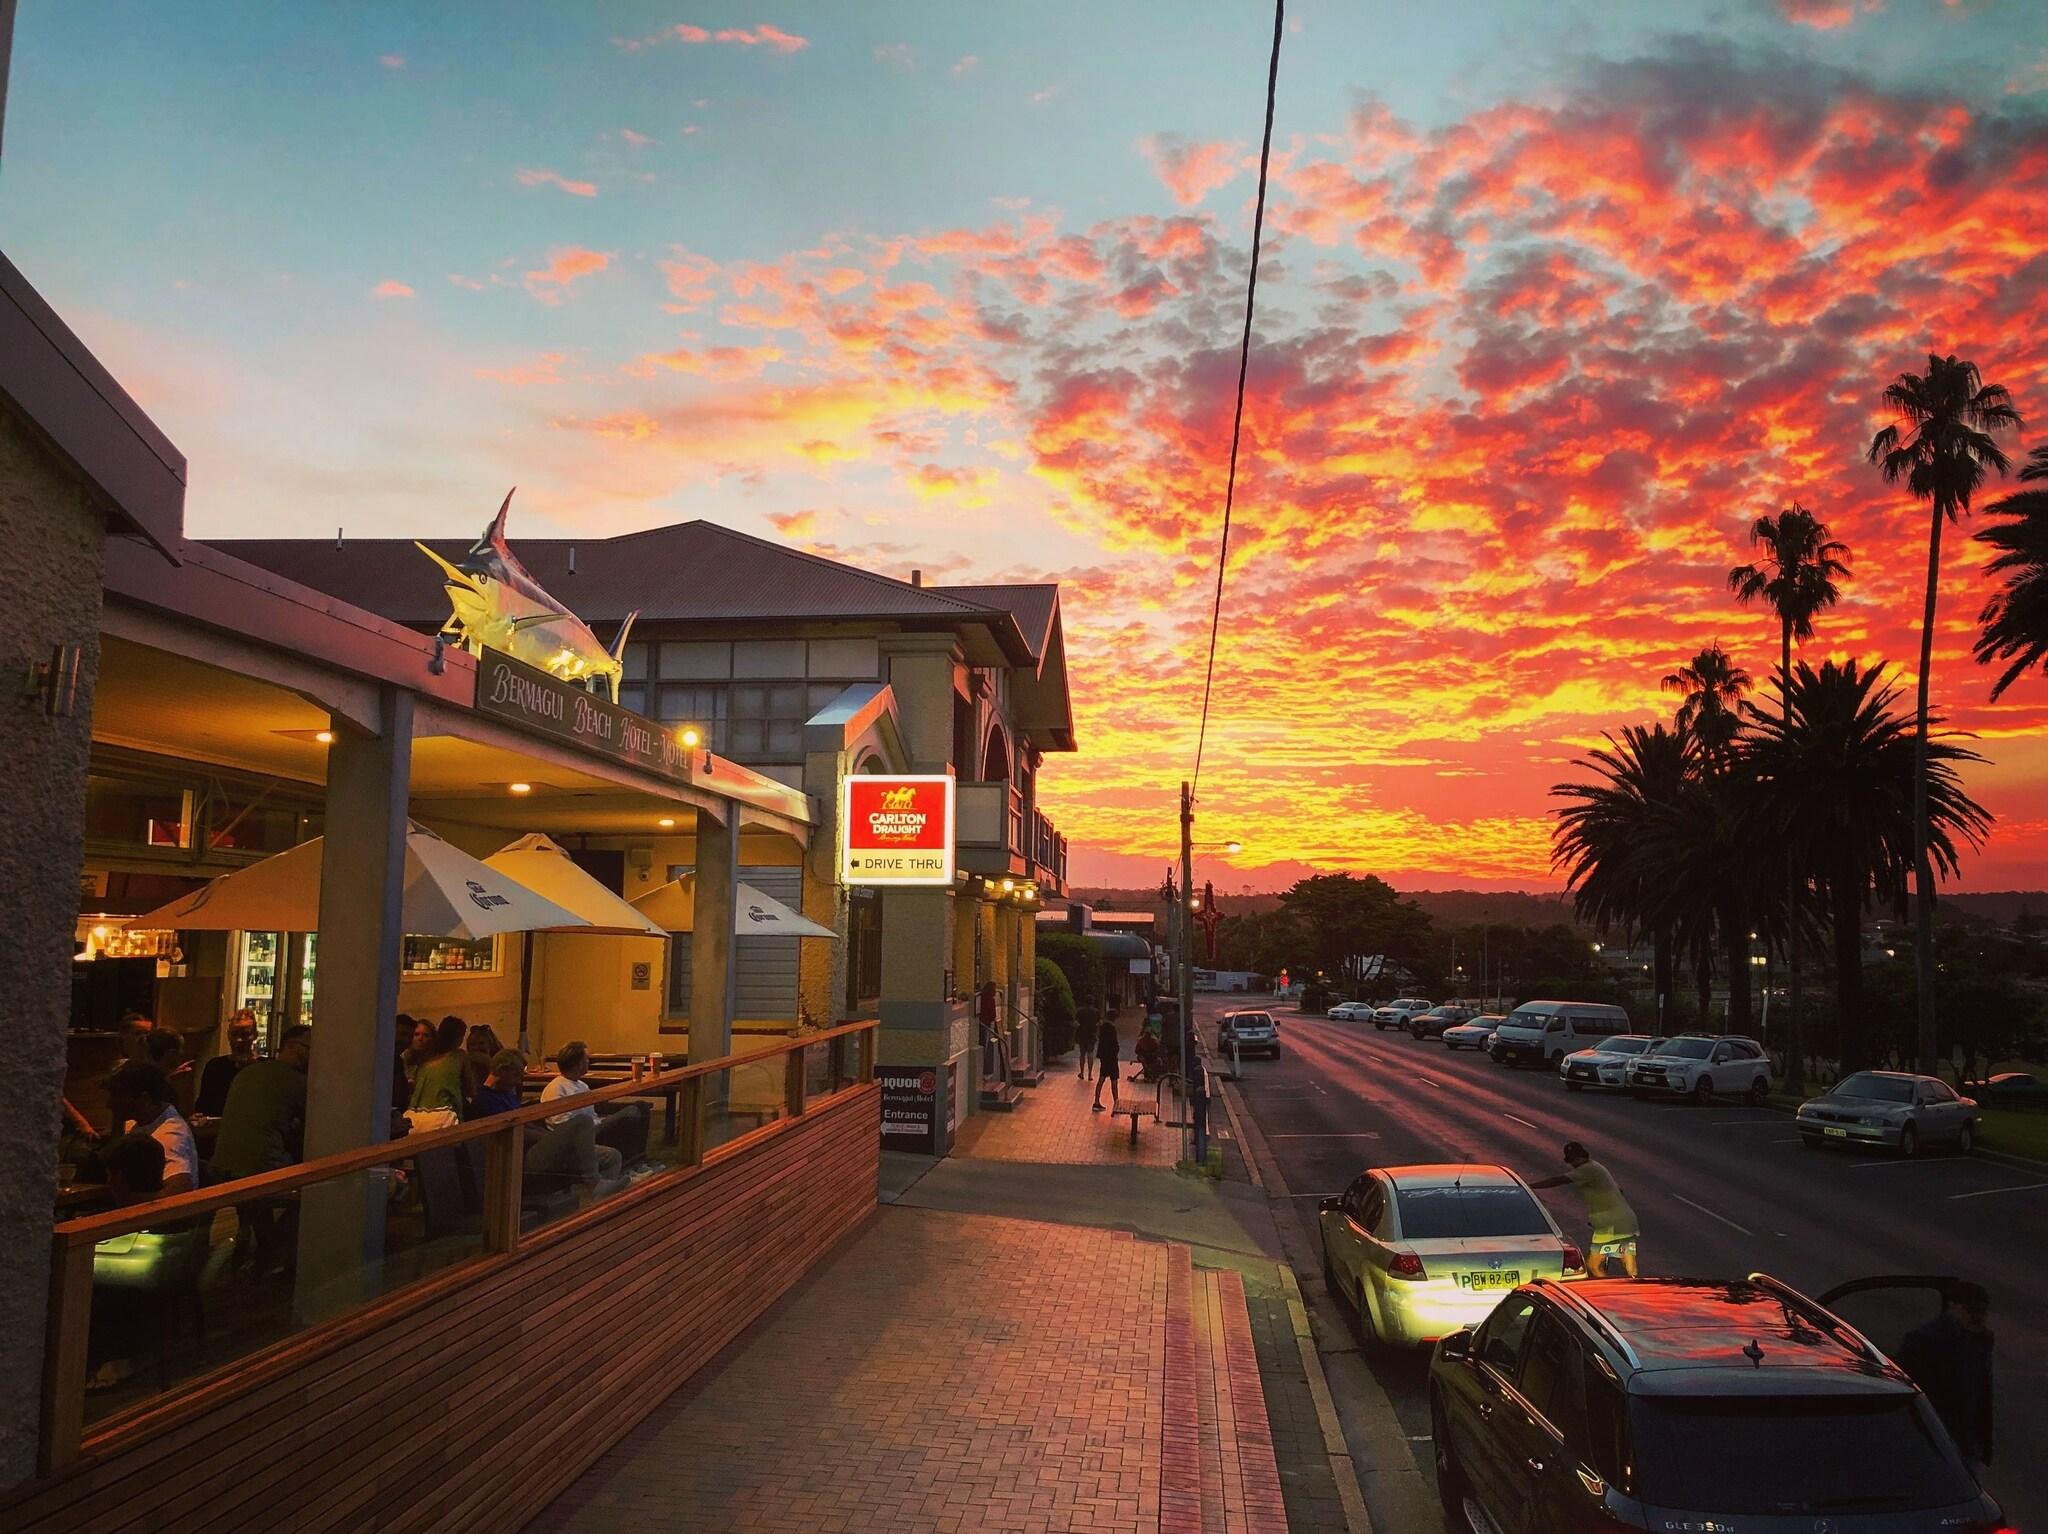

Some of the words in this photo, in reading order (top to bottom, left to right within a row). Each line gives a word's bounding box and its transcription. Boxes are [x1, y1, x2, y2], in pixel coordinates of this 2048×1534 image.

[490, 663, 564, 720] BERMAGUI
[573, 696, 612, 739] BEACH
[868, 813, 927, 825] CARLTON
[872, 824, 923, 834] DRAUGHT
[865, 858, 904, 869] DRIVE
[908, 858, 943, 870] THRU
[884, 1109, 929, 1120] Entrance
[1462, 1275, 1471, 1288] P
[1665, 1520, 1691, 1531] GLE
